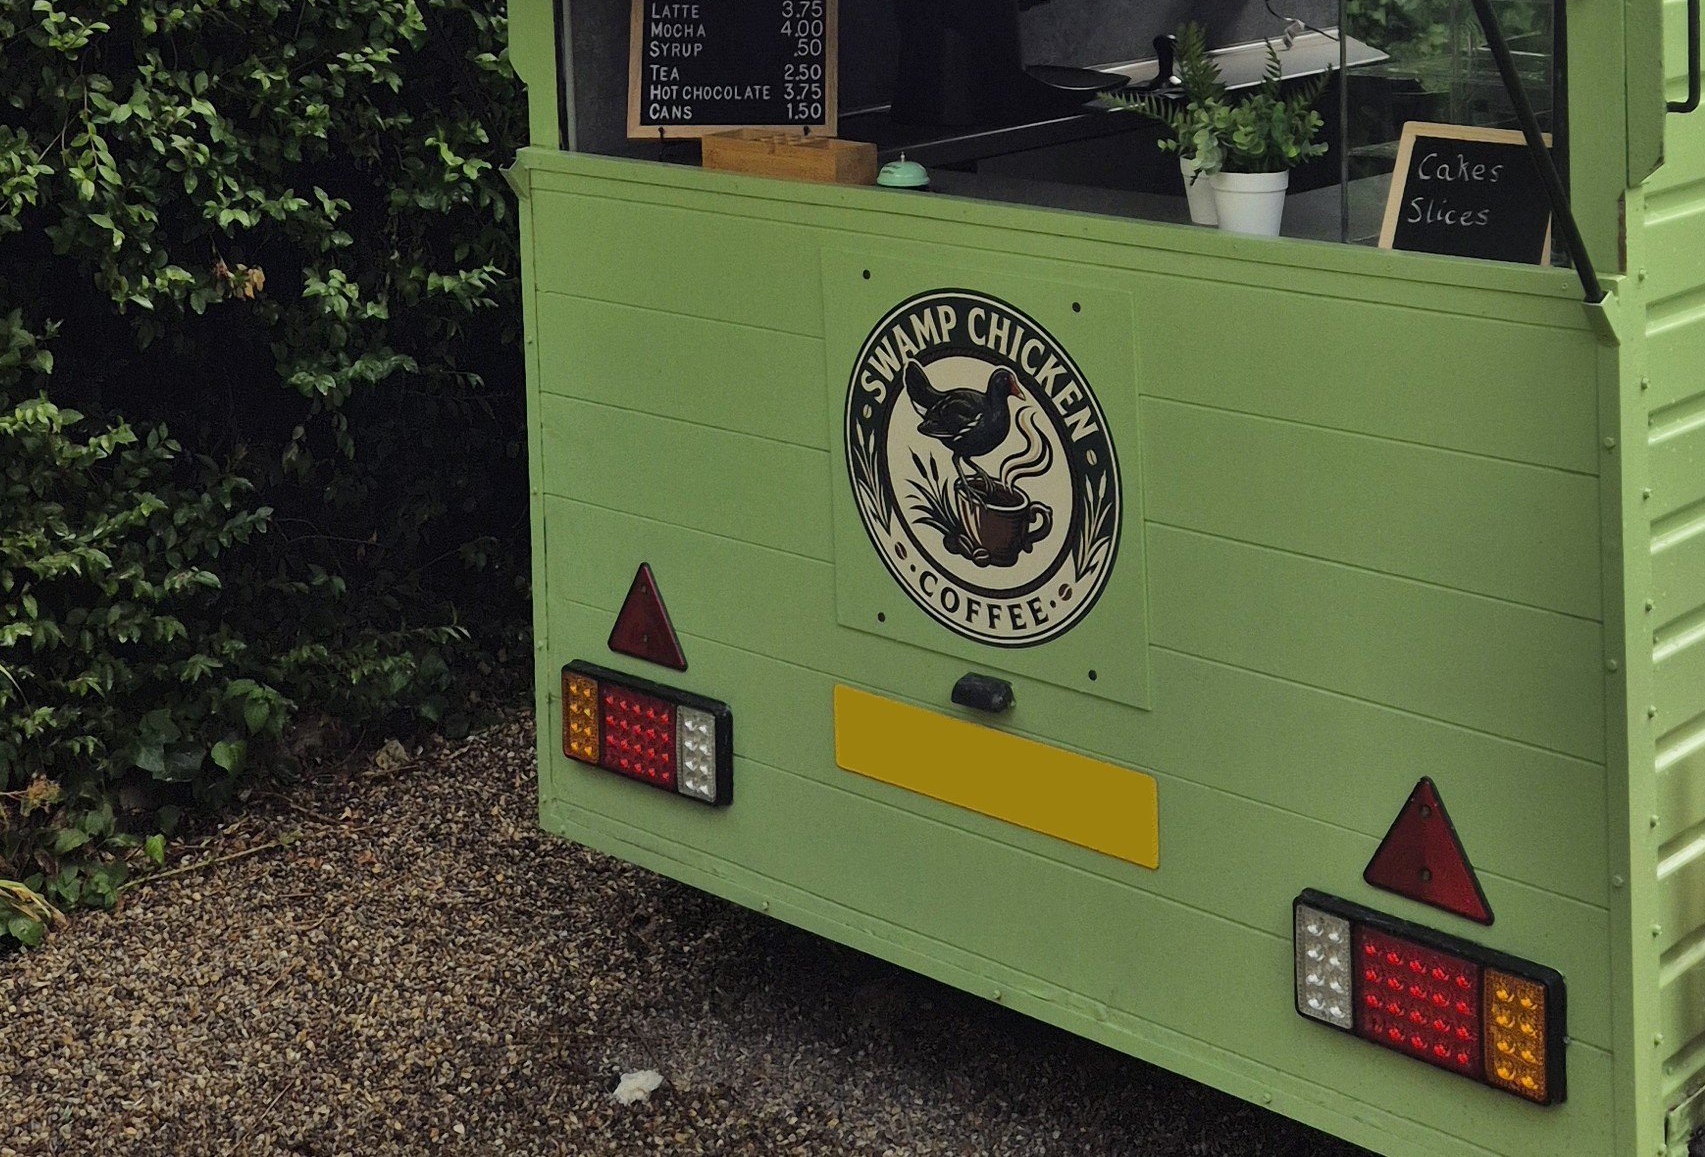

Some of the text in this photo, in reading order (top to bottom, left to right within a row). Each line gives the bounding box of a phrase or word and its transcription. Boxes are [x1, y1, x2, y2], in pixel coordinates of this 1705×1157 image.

[651, 0, 823, 19] LATTE 3.75
[650, 20, 823, 38] MOCHA 4.00
[649, 39, 822, 58] SYRUP .50
[650, 64, 822, 81] TEA 2.50
[650, 84, 822, 101] HOT CHOCOLATE 3.75
[649, 103, 822, 120] CANS 1.50
[1418, 152, 1505, 183] Cakes
[1407, 197, 1492, 227] Slices
[861, 305, 1100, 443] SWAMP CHICKEN
[919, 569, 1052, 630] COFFEE
